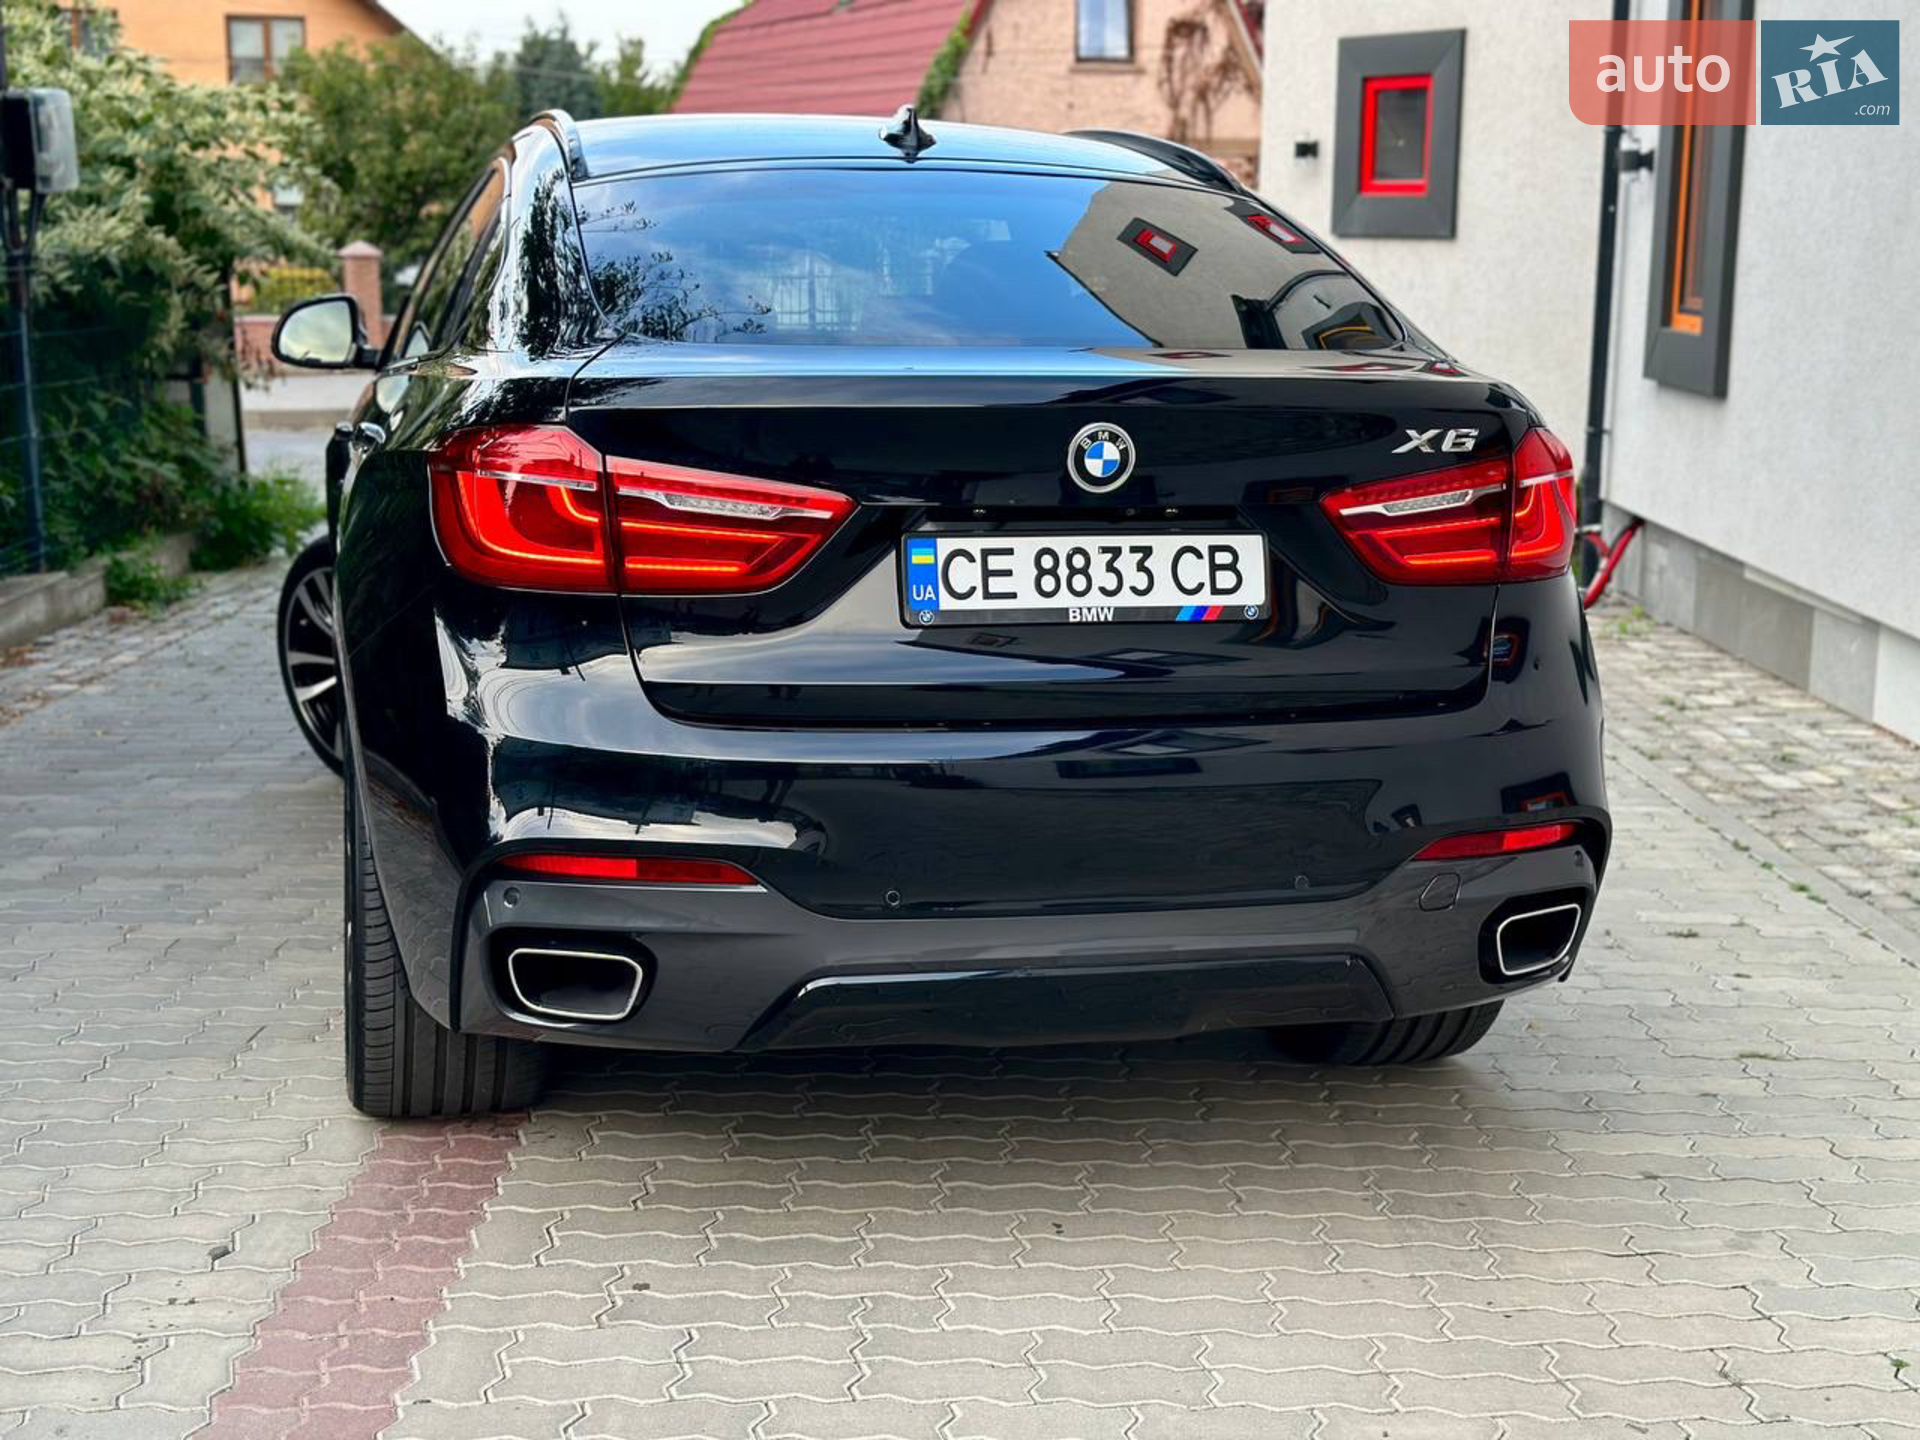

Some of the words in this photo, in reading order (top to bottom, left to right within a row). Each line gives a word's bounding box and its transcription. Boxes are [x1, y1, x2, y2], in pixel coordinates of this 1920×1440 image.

[1080, 431, 1127, 450] BMW
[1391, 429, 1479, 453] X6
[941, 547, 1017, 600] CE
[1034, 546, 1155, 598] 8833
[1171, 545, 1243, 596] CB
[912, 584, 936, 600] UA
[1068, 607, 1114, 622] BMW
